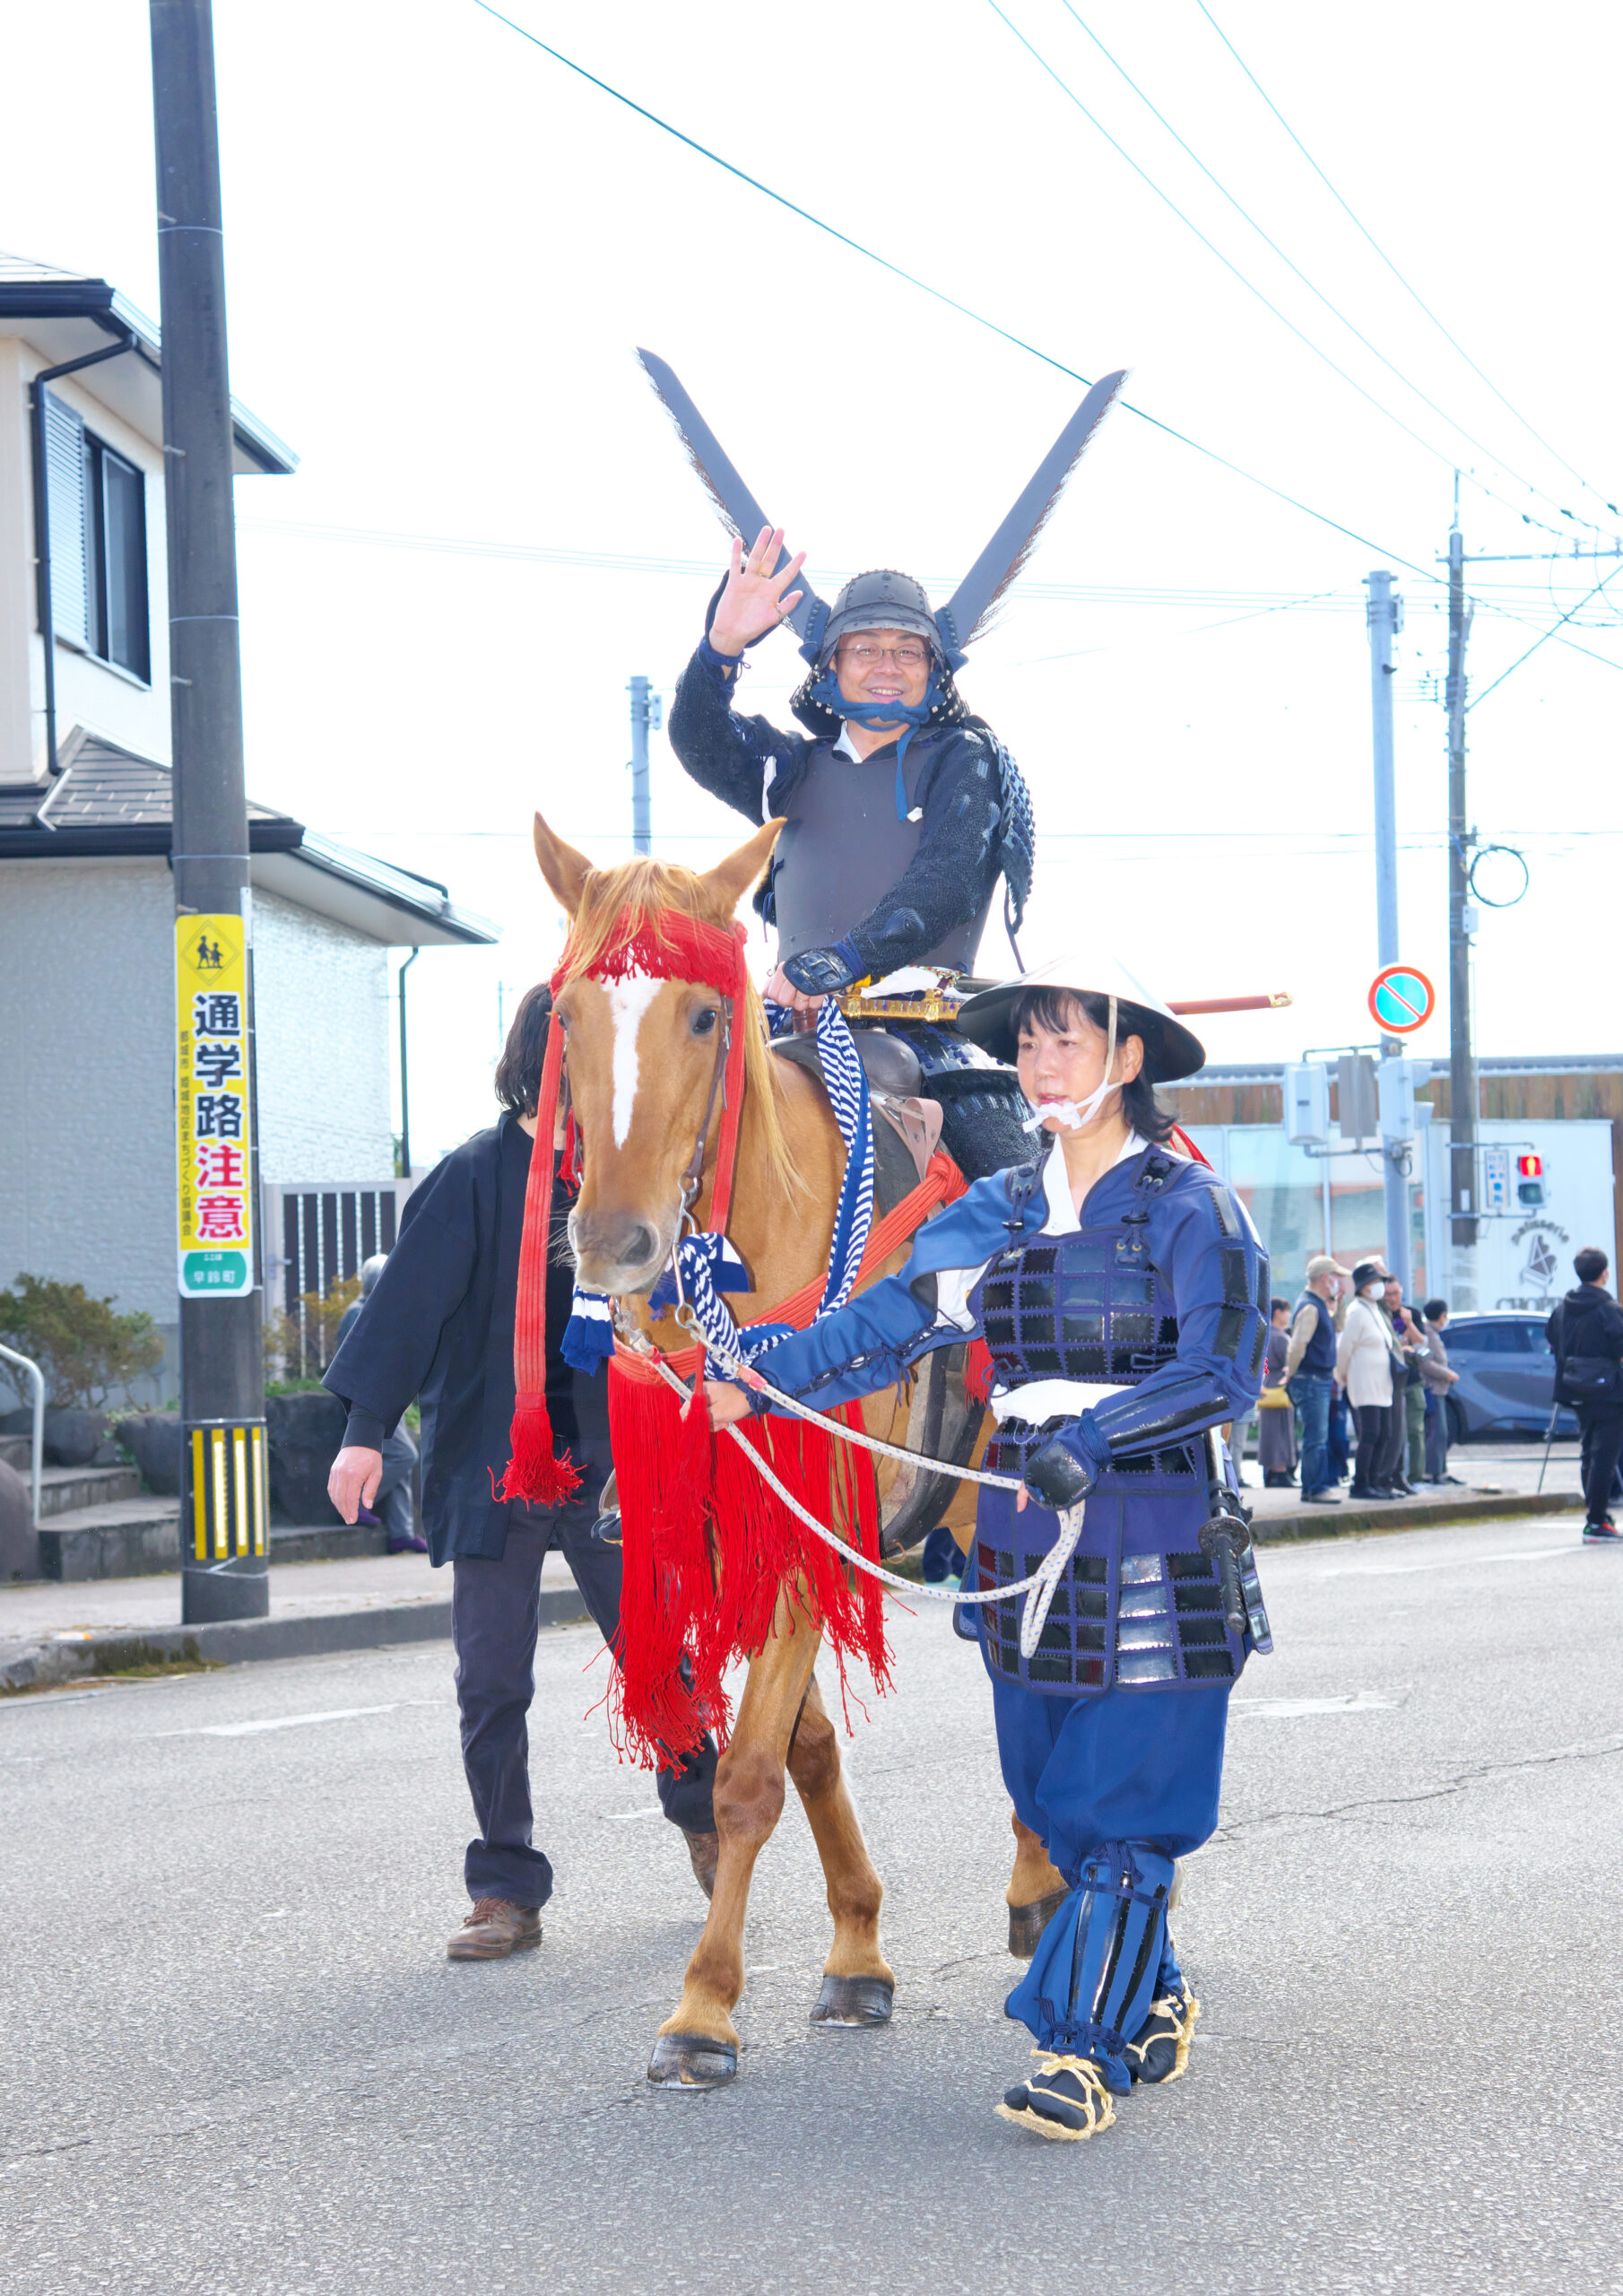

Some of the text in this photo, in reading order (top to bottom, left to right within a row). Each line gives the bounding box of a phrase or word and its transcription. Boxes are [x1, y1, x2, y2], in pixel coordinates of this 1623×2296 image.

[195, 995, 243, 1238] 通学路注意
